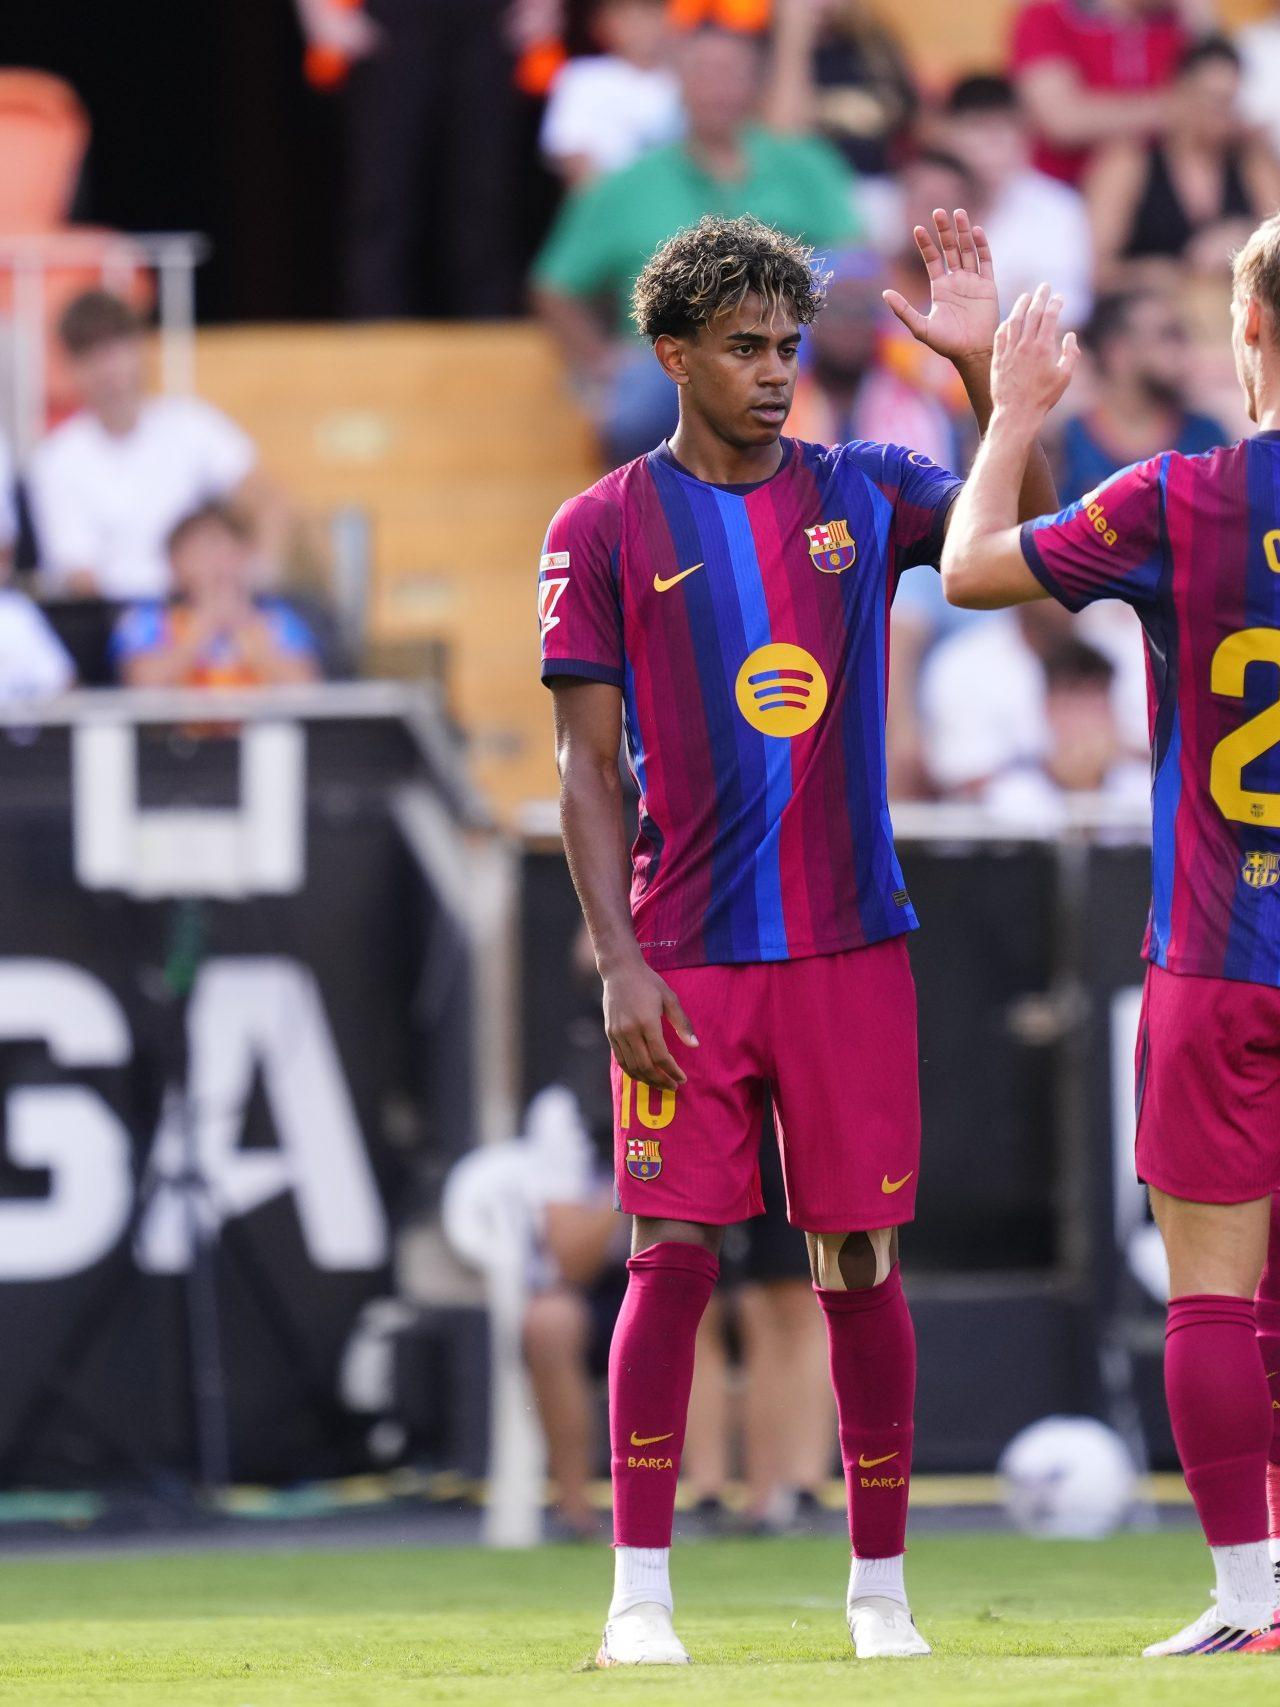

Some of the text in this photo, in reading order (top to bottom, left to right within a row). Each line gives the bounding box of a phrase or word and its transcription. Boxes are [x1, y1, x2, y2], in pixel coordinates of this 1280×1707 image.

[620, 1068, 676, 1129] 10
[627, 1456, 673, 1471] BARÇA
[861, 1476, 906, 1489] BARÇA
